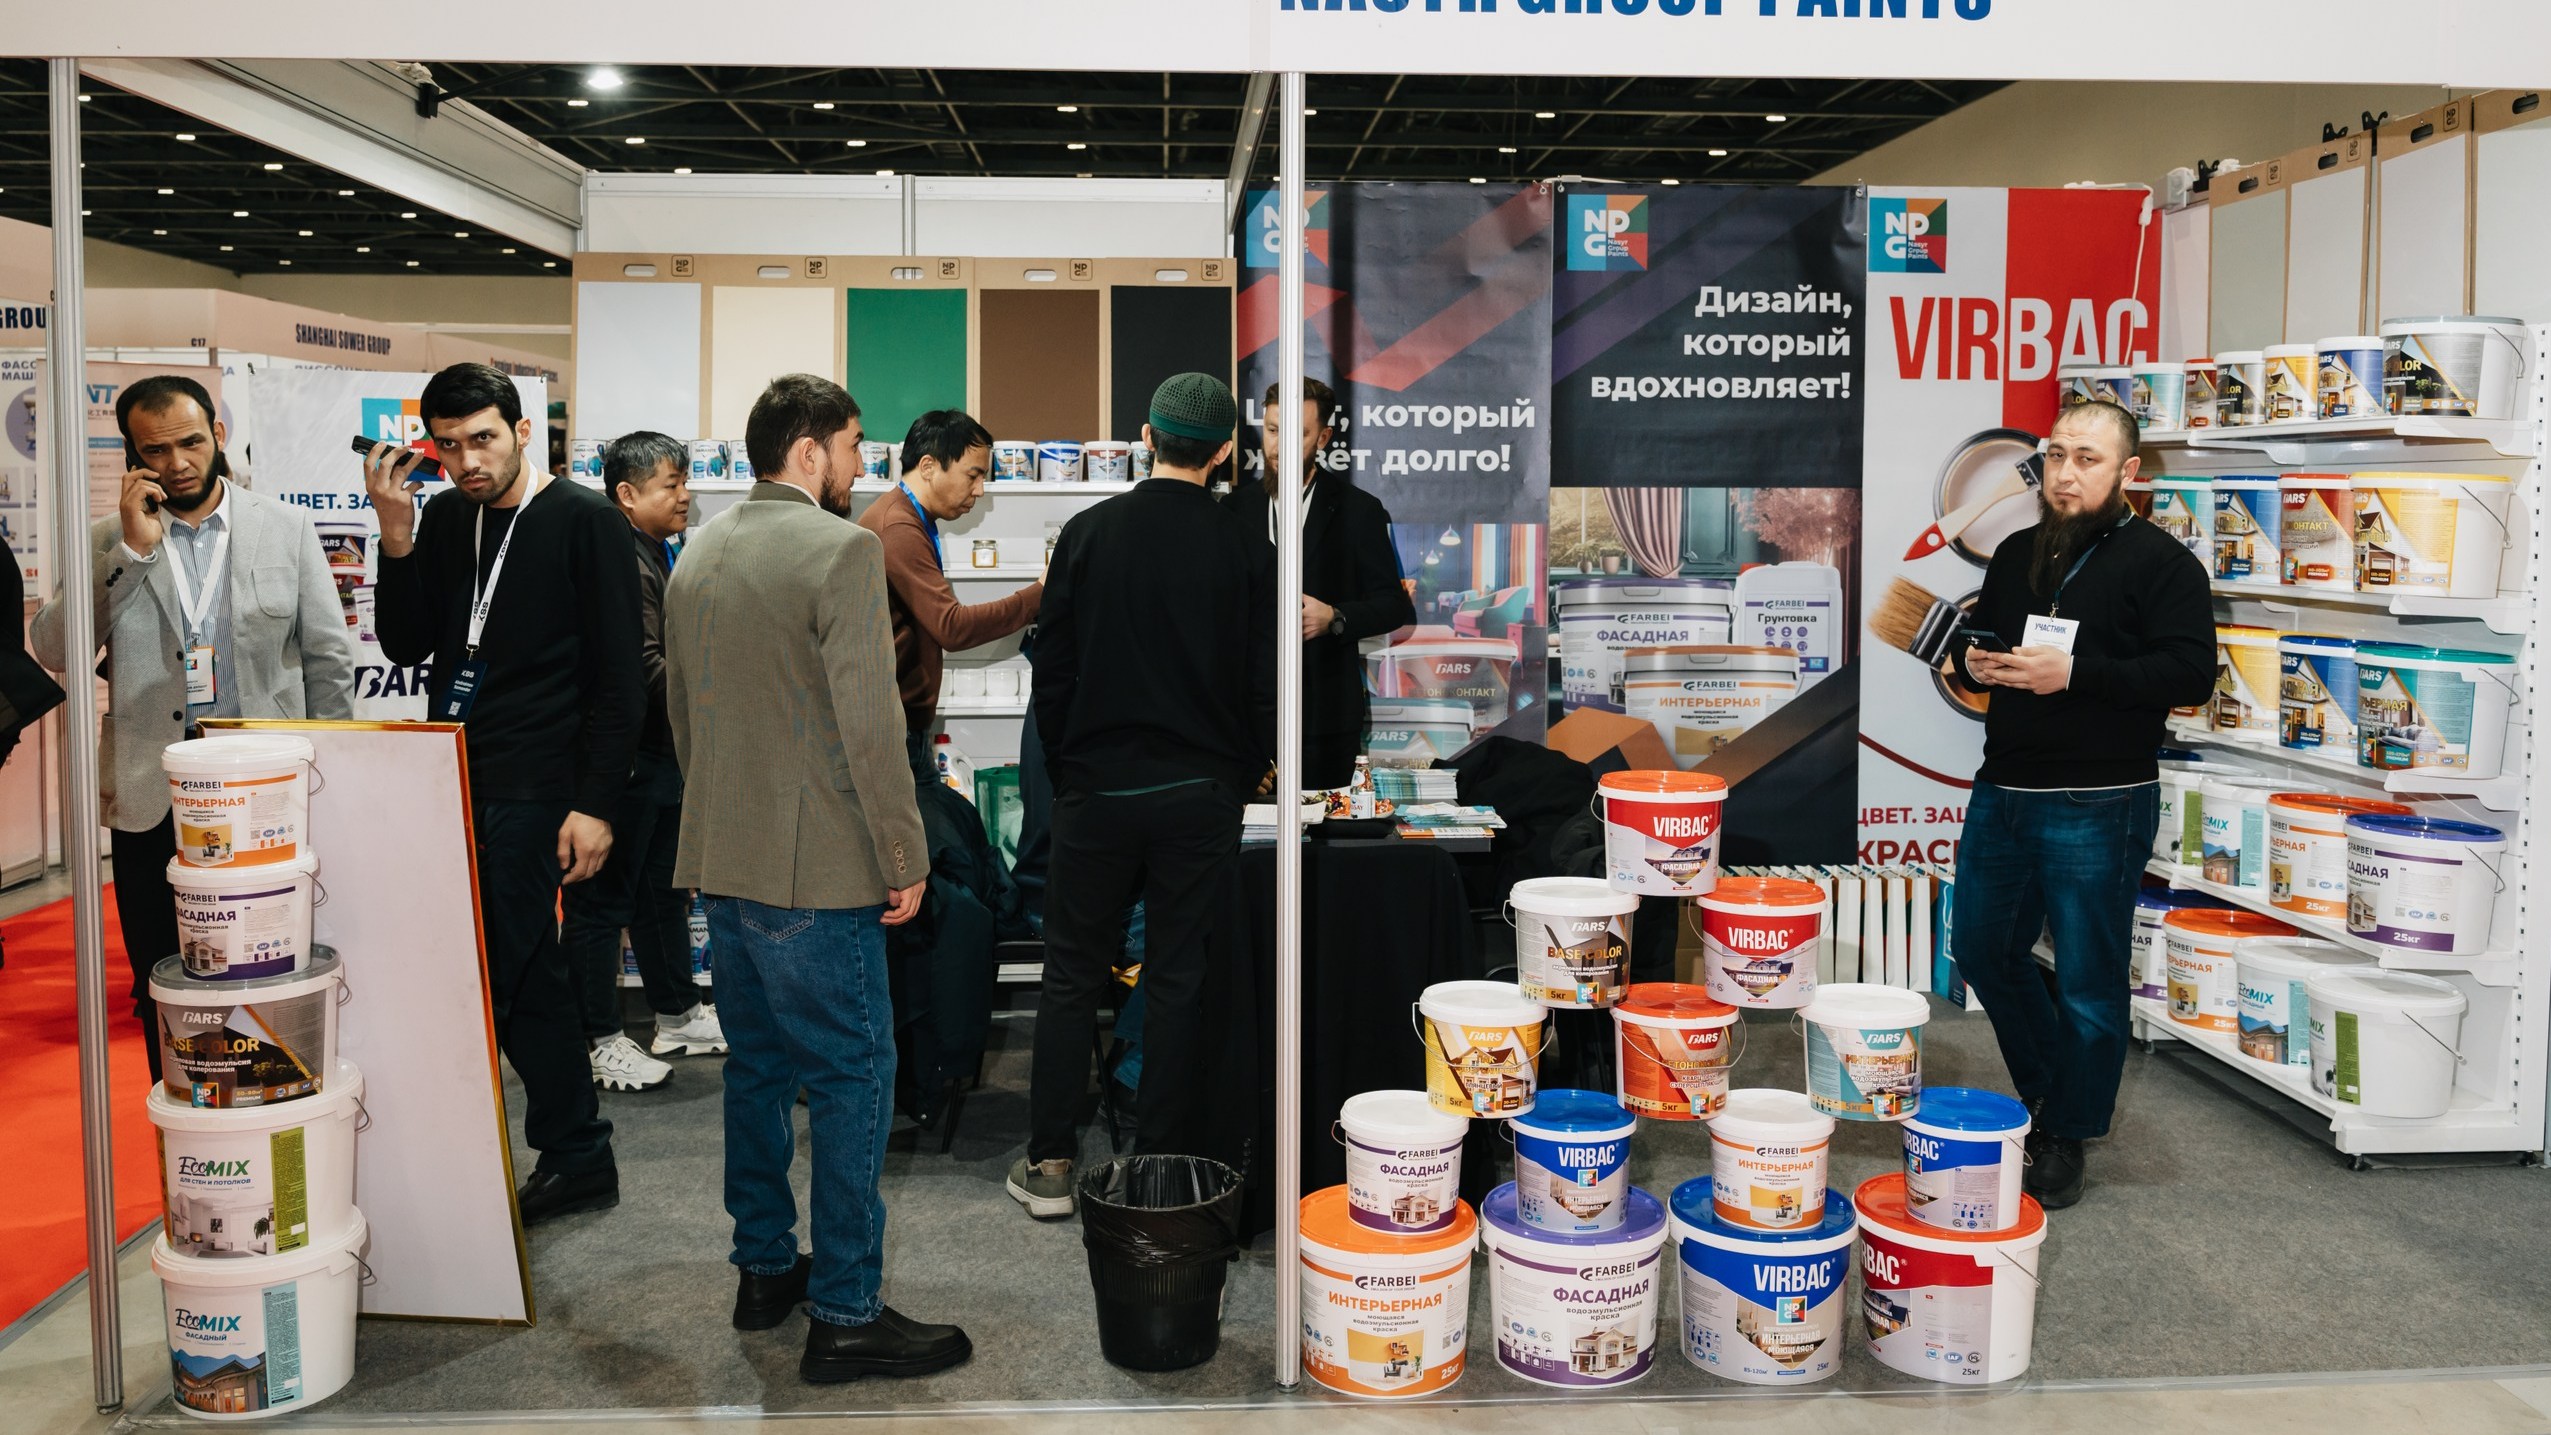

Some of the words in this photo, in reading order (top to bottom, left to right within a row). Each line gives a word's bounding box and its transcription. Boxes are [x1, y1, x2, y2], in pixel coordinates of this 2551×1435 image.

[1695, 286, 1853, 317] Дизайн,
[191, 338, 206, 347] C17
[296, 323, 337, 348] SHANGHAI
[338, 331, 367, 351] SOWER
[367, 335, 391, 356] GROUP
[1889, 296, 2148, 382] VIRBAC
[1683, 329, 1851, 363] который
[1592, 372, 1851, 403] вдохновляет!
[1361, 401, 1536, 435] который
[1244, 441, 1372, 471] жвёт
[1382, 445, 1511, 476] долго!
[1775, 600, 1806, 608] FARBEI
[1631, 614, 1670, 622] FARBEI
[1758, 613, 1817, 624] Грунтовка
[2034, 622, 2067, 635] УЧАСТНИК
[1597, 629, 1689, 644] ФАСАДНАЯ
[1436, 664, 1471, 674] BARS
[1659, 697, 1761, 708] ИНТЕРЬЕРНАЯ
[188, 781, 221, 790] FARBEI
[1653, 816, 1709, 837] VIRBAC
[2351, 843, 2373, 856] FARBEI
[187, 894, 217, 903] FARBEI
[2306, 902, 2331, 912] 25кг
[1571, 921, 1606, 932] BARS
[1728, 927, 1788, 950] VIRBAC
[2393, 932, 2421, 943] 25кг
[1547, 946, 1581, 960] BASE
[1585, 945, 1622, 960] COLOR
[1551, 990, 1566, 1000] 5кг
[182, 1011, 224, 1024] BARS
[1469, 1032, 1502, 1042] BARS
[1688, 1033, 1719, 1044] BARS
[1867, 1033, 1901, 1044] BARS
[1450, 1097, 1463, 1107] 5кг
[1662, 1103, 1678, 1112] 5кг
[1408, 1149, 1438, 1158] FARBEI
[1558, 1144, 1616, 1168] VIRBAC
[1767, 1148, 1799, 1156] FARBEI
[1380, 1162, 1449, 1177] ФАСАДНАЯ
[1738, 1159, 1814, 1173] ИНТЕРЬЕРНАЯ
[213, 1178, 251, 1186] ПОТОЛКОВ
[1595, 1262, 1635, 1277] FARBEI
[1370, 1276, 1416, 1287] FARBEI
[1753, 1261, 1830, 1293] VIRBAC
[1553, 1278, 1649, 1305] ФАСАДНАЯ
[1329, 1291, 1442, 1312] ИНТЕРЬЕРНАЯ
[1566, 1300, 1643, 1315] водоэмульсионная
[185, 1331, 227, 1342] ФАСАДНЫЙ
[1761, 1331, 1821, 1345] ИНТЕРЬЕРНАЯ
[1767, 1344, 1815, 1355] МОЮЩАЯСЯ
[1962, 1368, 1981, 1376] 25кг
